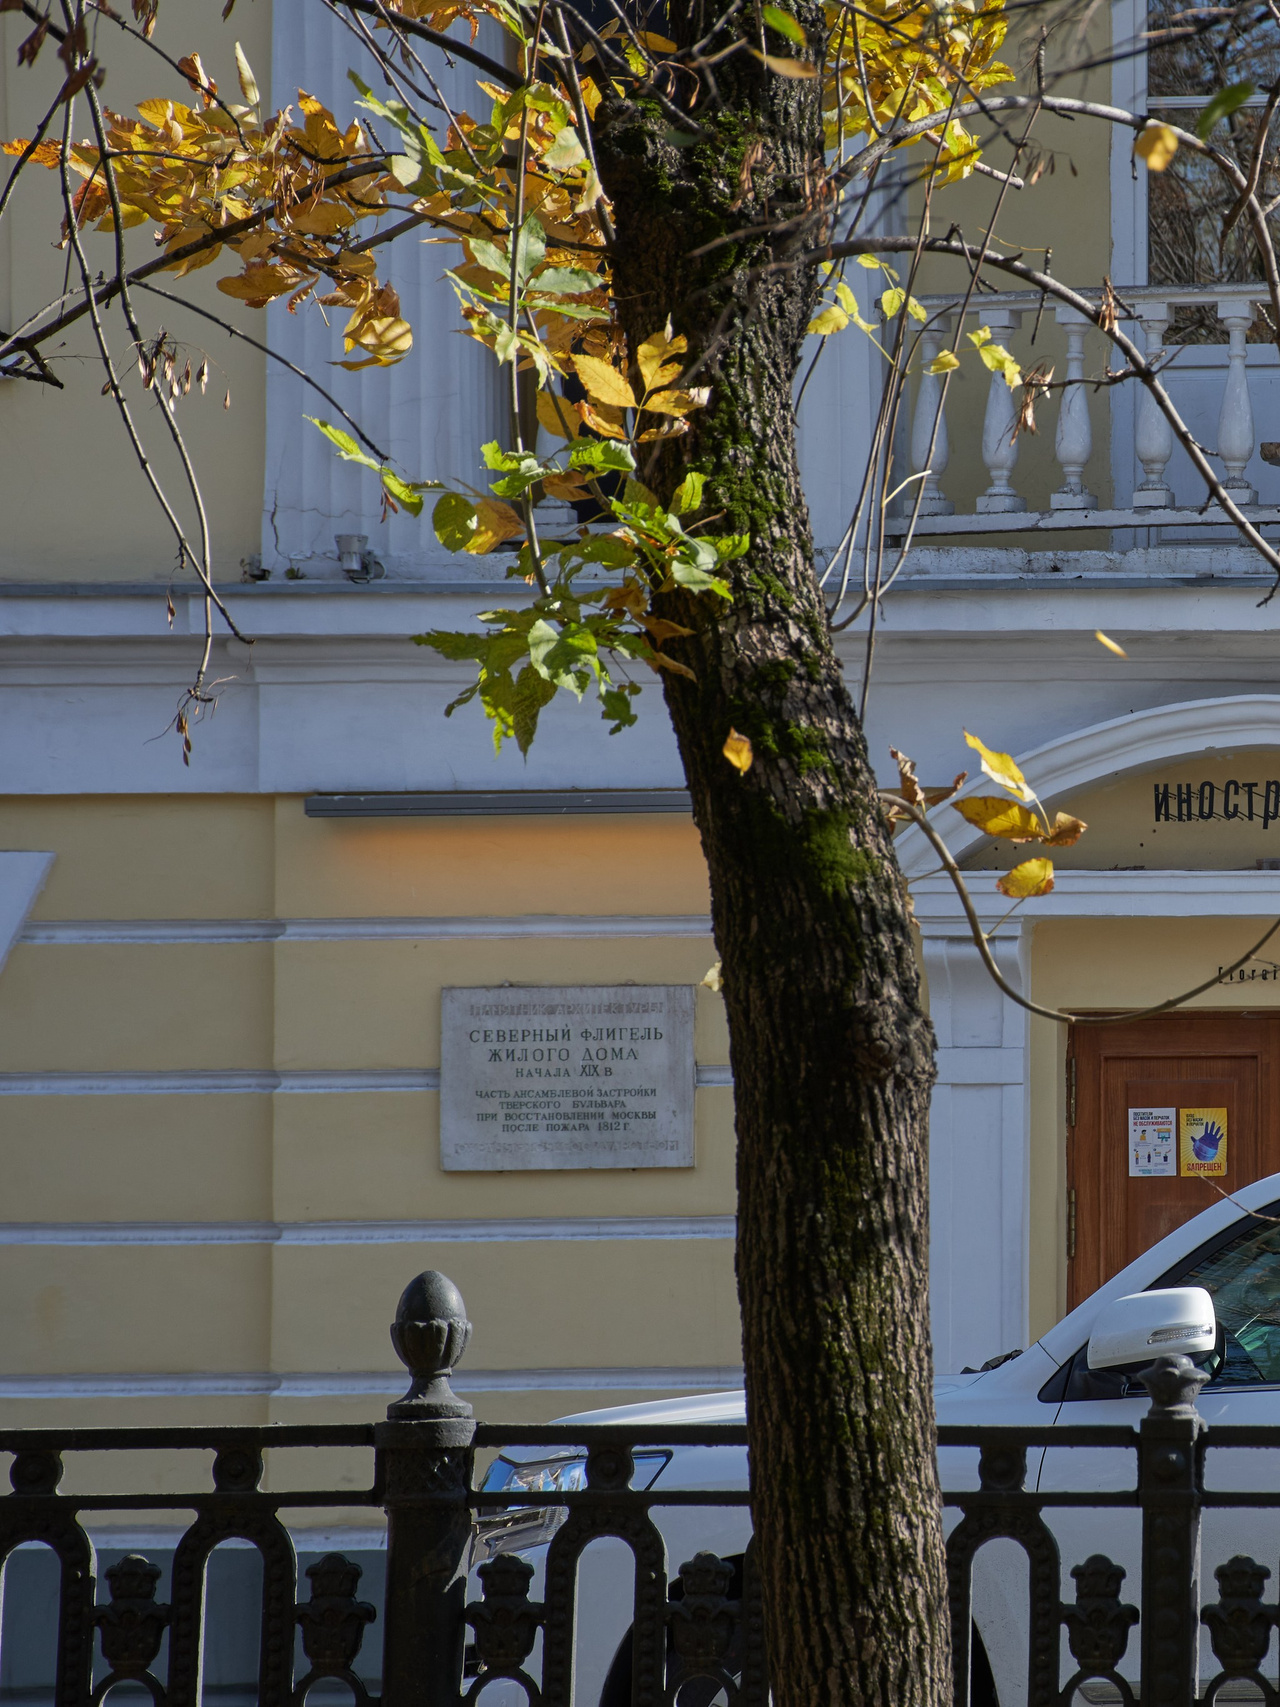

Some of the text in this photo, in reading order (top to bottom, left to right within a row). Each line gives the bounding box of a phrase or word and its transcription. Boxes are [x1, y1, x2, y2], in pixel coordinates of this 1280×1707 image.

[470, 1002, 664, 1016] ПАМЯТНИК АРХИТЕКТУРЫ
[469, 1024, 664, 1043] СЕВЕРНЫЙ ФЛИГЕЛЬ
[488, 1047, 639, 1063] ЖИЛОГО ДОМА
[515, 1067, 571, 1079] НАЧАЛА
[579, 1064, 600, 1077] XIX
[475, 1085, 657, 1099] ЧАСТЬ АНСАМБЛЕВОЙ ЗАСТРОЙКИ
[498, 1099, 627, 1110] ТВЕРСКОГО БУЛЬВАРА
[476, 1110, 657, 1122] ПРИ ВОССТАНОВЛЕНИИ МОСКВЫ
[502, 1123, 539, 1133] ПОСЛЕ
[546, 1122, 590, 1132] ПОЖАРА
[598, 1121, 621, 1132] 1812
[1187, 1162, 1222, 1172] ЗАПРЕЩЕН
